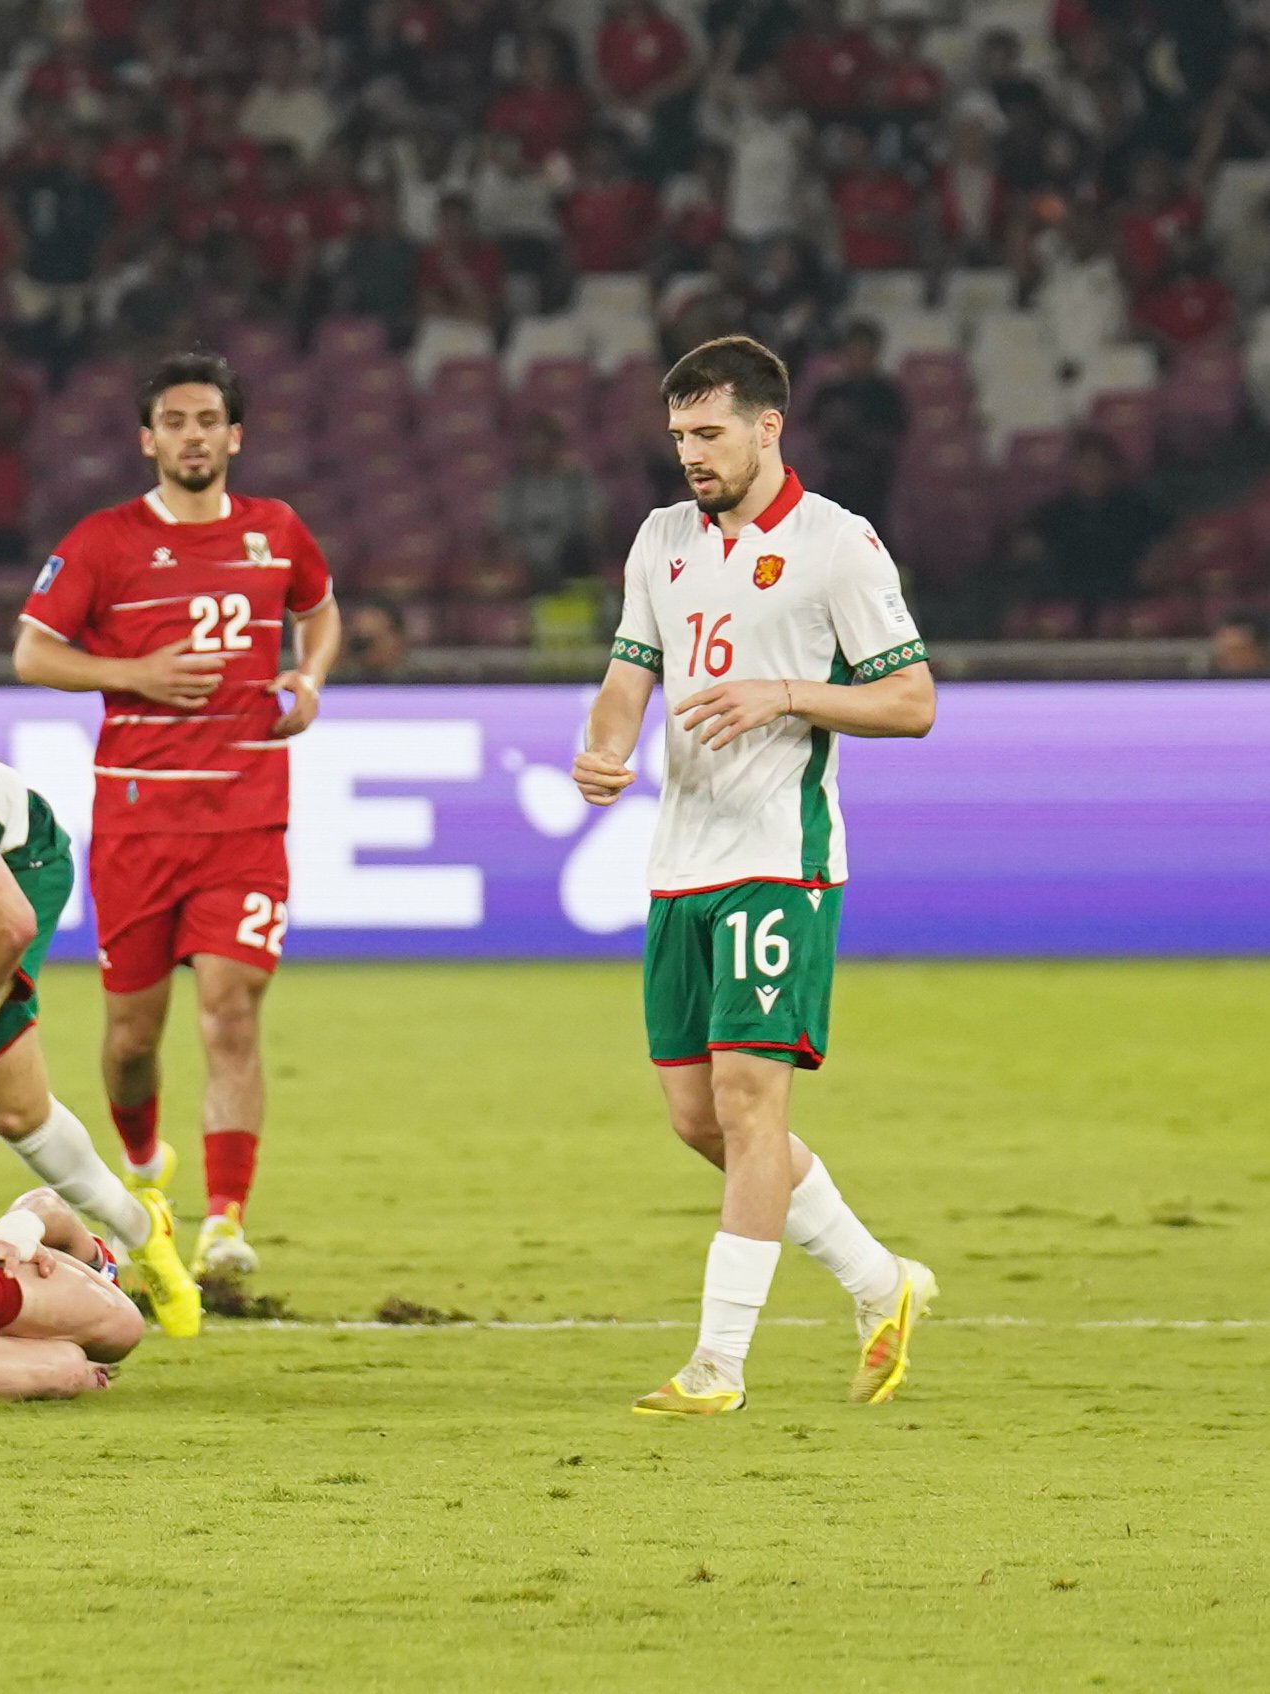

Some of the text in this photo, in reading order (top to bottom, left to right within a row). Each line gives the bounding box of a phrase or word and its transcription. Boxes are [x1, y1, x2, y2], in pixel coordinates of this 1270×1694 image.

[189, 593, 252, 652] 22
[687, 612, 733, 677] 16
[235, 891, 288, 957] 22
[726, 908, 790, 979] 16
